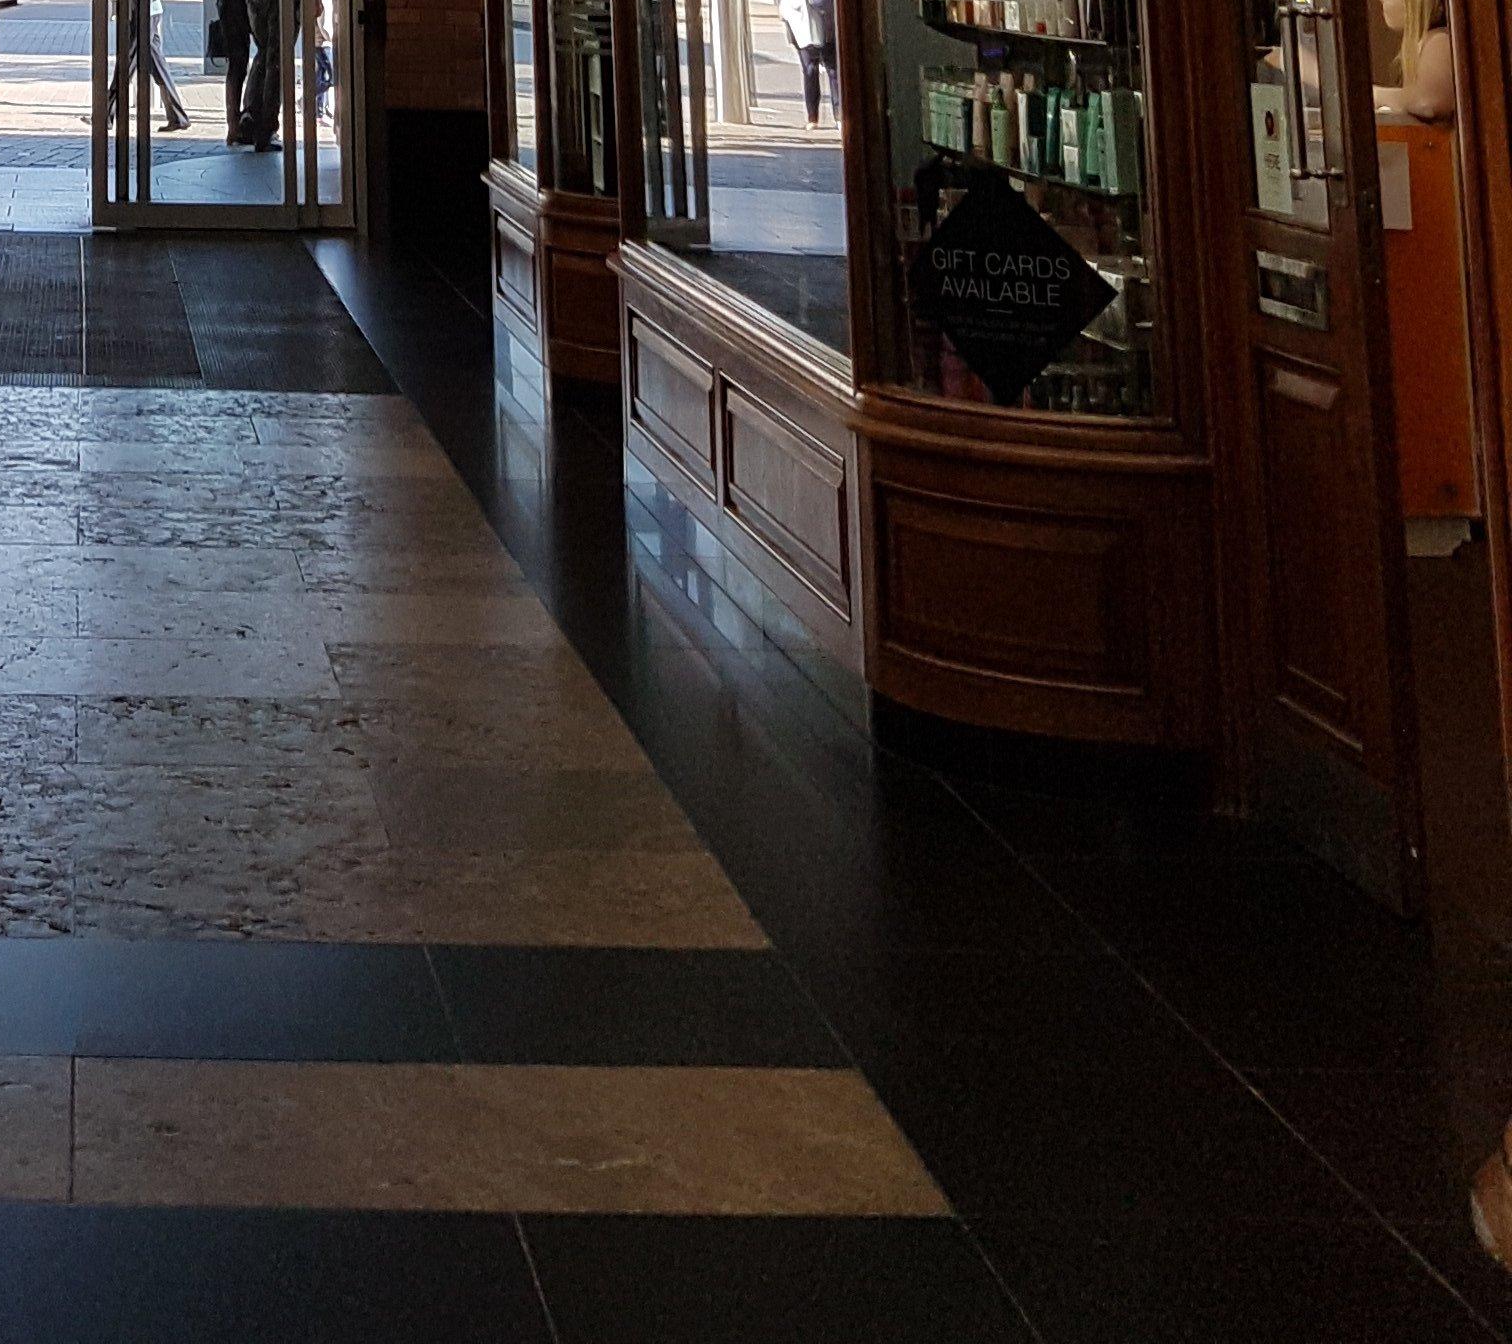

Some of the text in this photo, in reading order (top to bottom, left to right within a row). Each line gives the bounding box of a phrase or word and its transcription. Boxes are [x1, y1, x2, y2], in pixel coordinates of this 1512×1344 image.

[932, 247, 1071, 280] GIFT CARDS
[941, 275, 1061, 307] AVAILABLE
